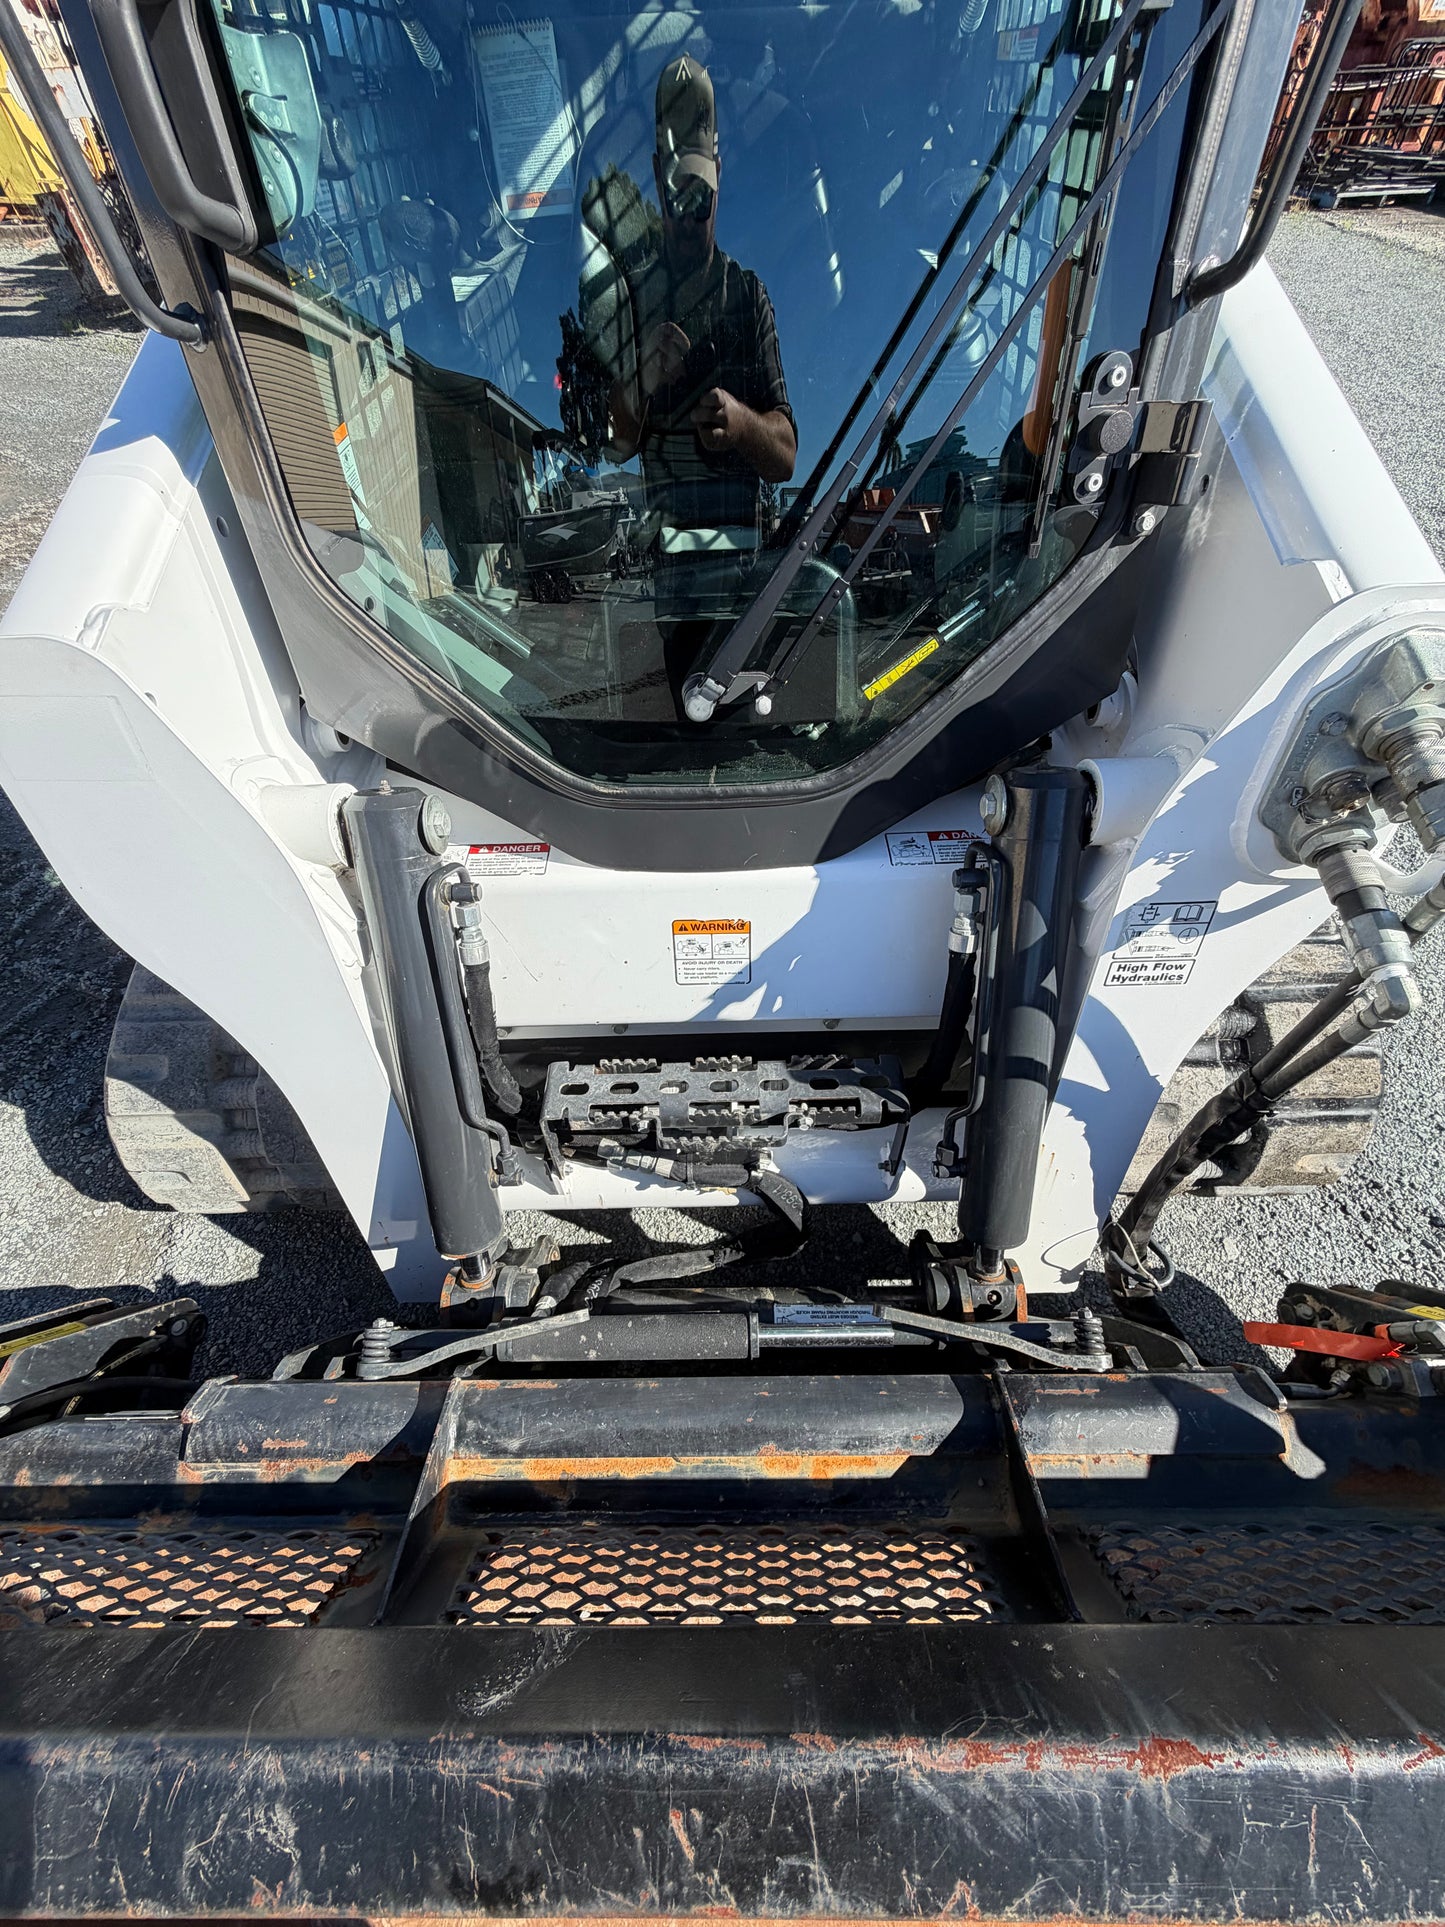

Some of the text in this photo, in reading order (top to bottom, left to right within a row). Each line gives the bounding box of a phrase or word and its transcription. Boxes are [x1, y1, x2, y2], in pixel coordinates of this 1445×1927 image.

[492, 845, 541, 853] DANGER
[690, 923, 745, 931] WARNING
[1116, 963, 1187, 973] High Flow
[1110, 973, 1184, 984] Hydraulics
